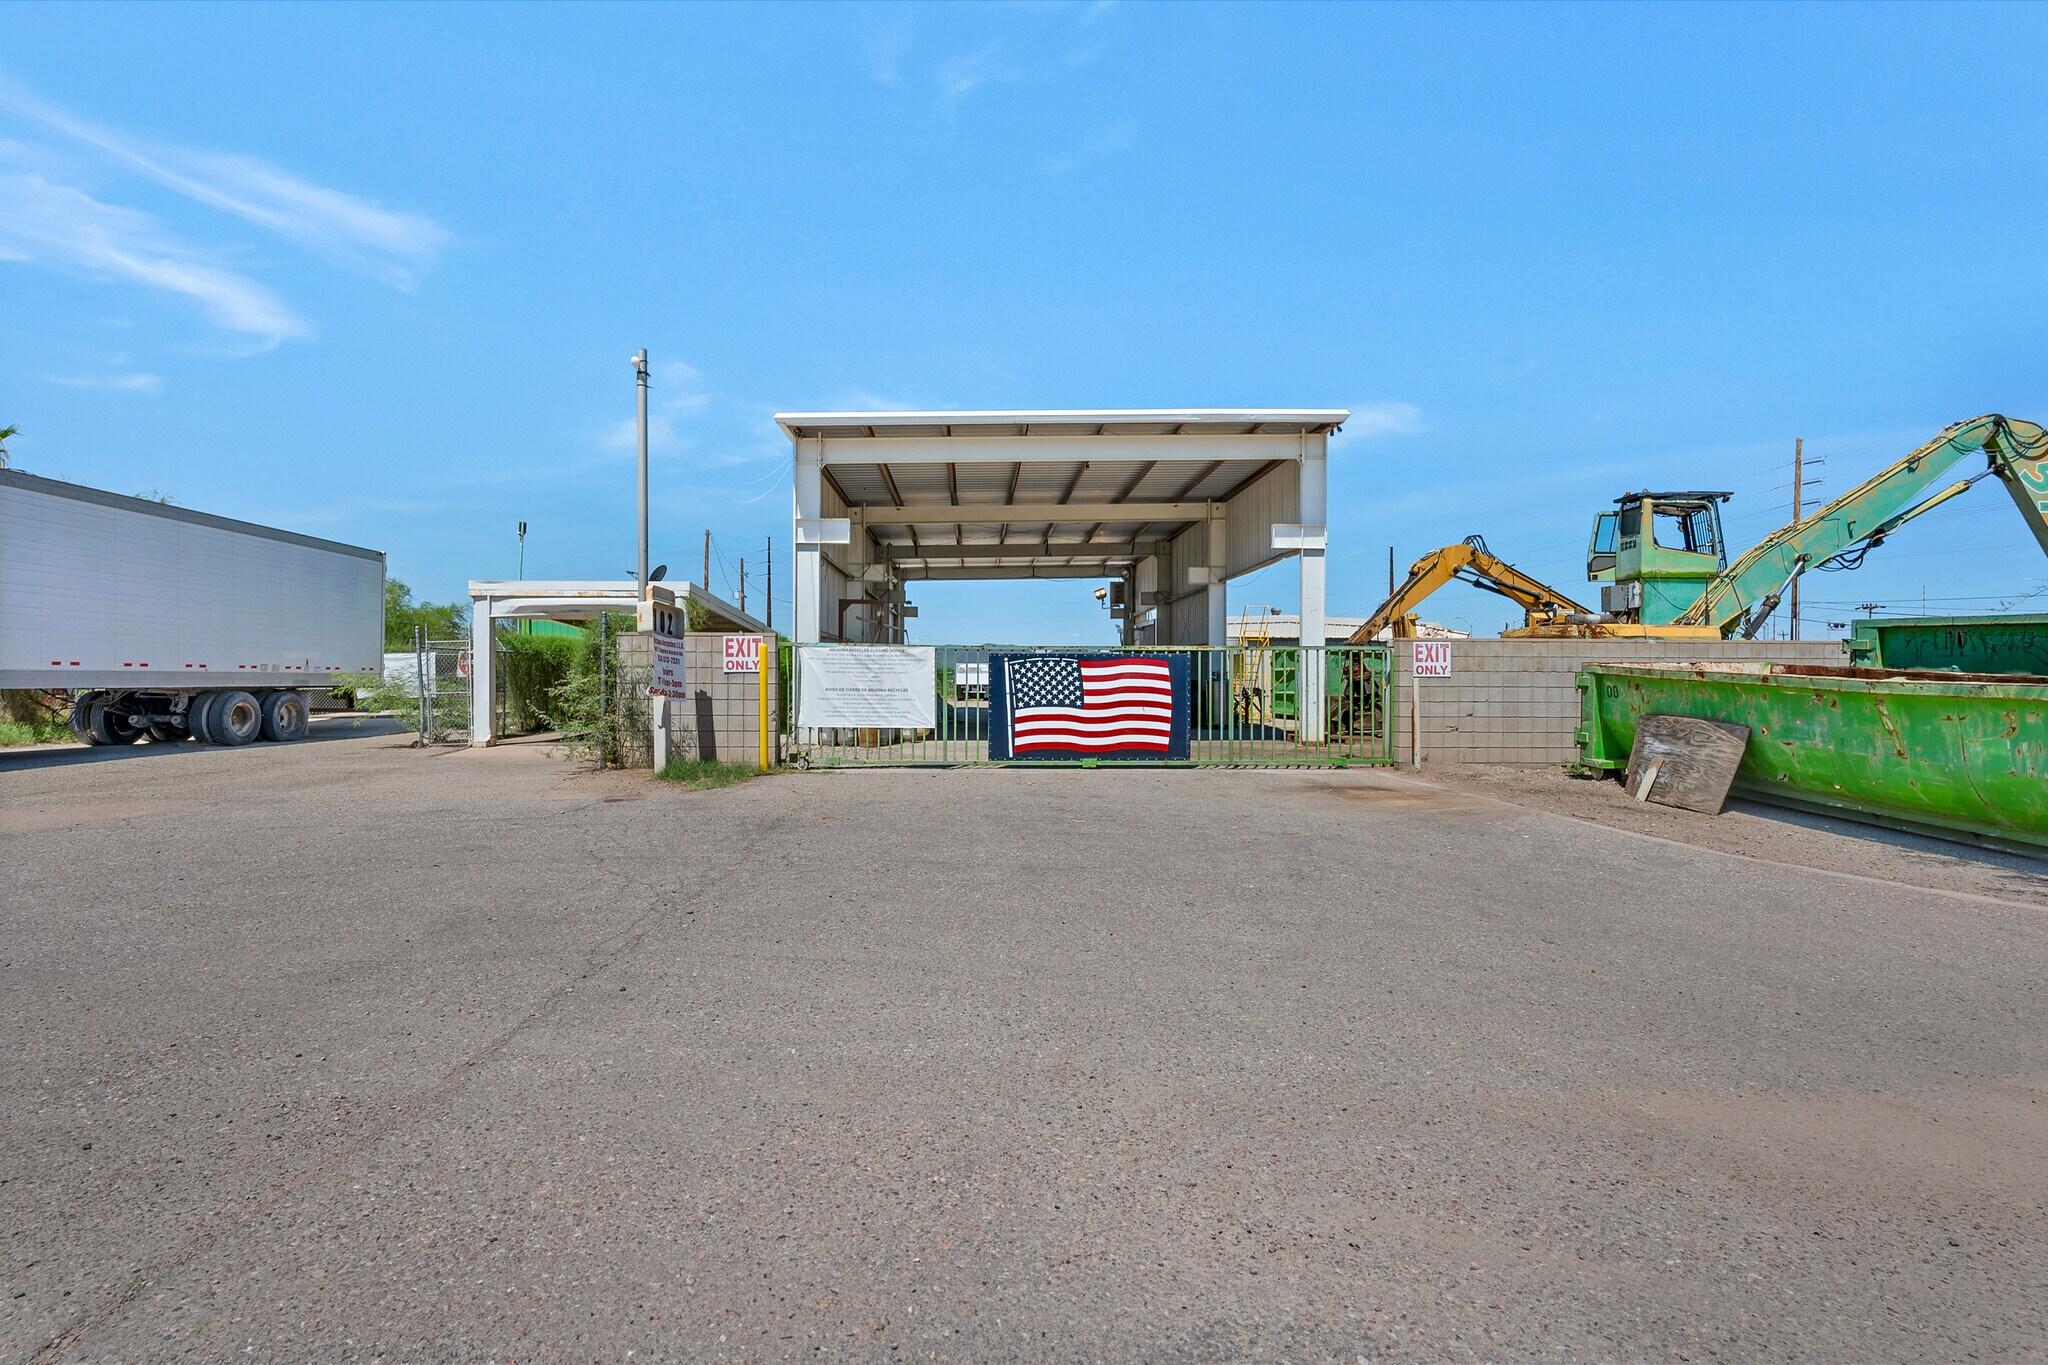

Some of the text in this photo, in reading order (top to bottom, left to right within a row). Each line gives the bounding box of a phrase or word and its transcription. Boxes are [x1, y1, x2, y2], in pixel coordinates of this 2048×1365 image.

[725, 638, 761, 657] EXIT
[1415, 644, 1449, 662] EXIT
[726, 660, 760, 670] ONLY
[1416, 665, 1448, 675] ONLY
